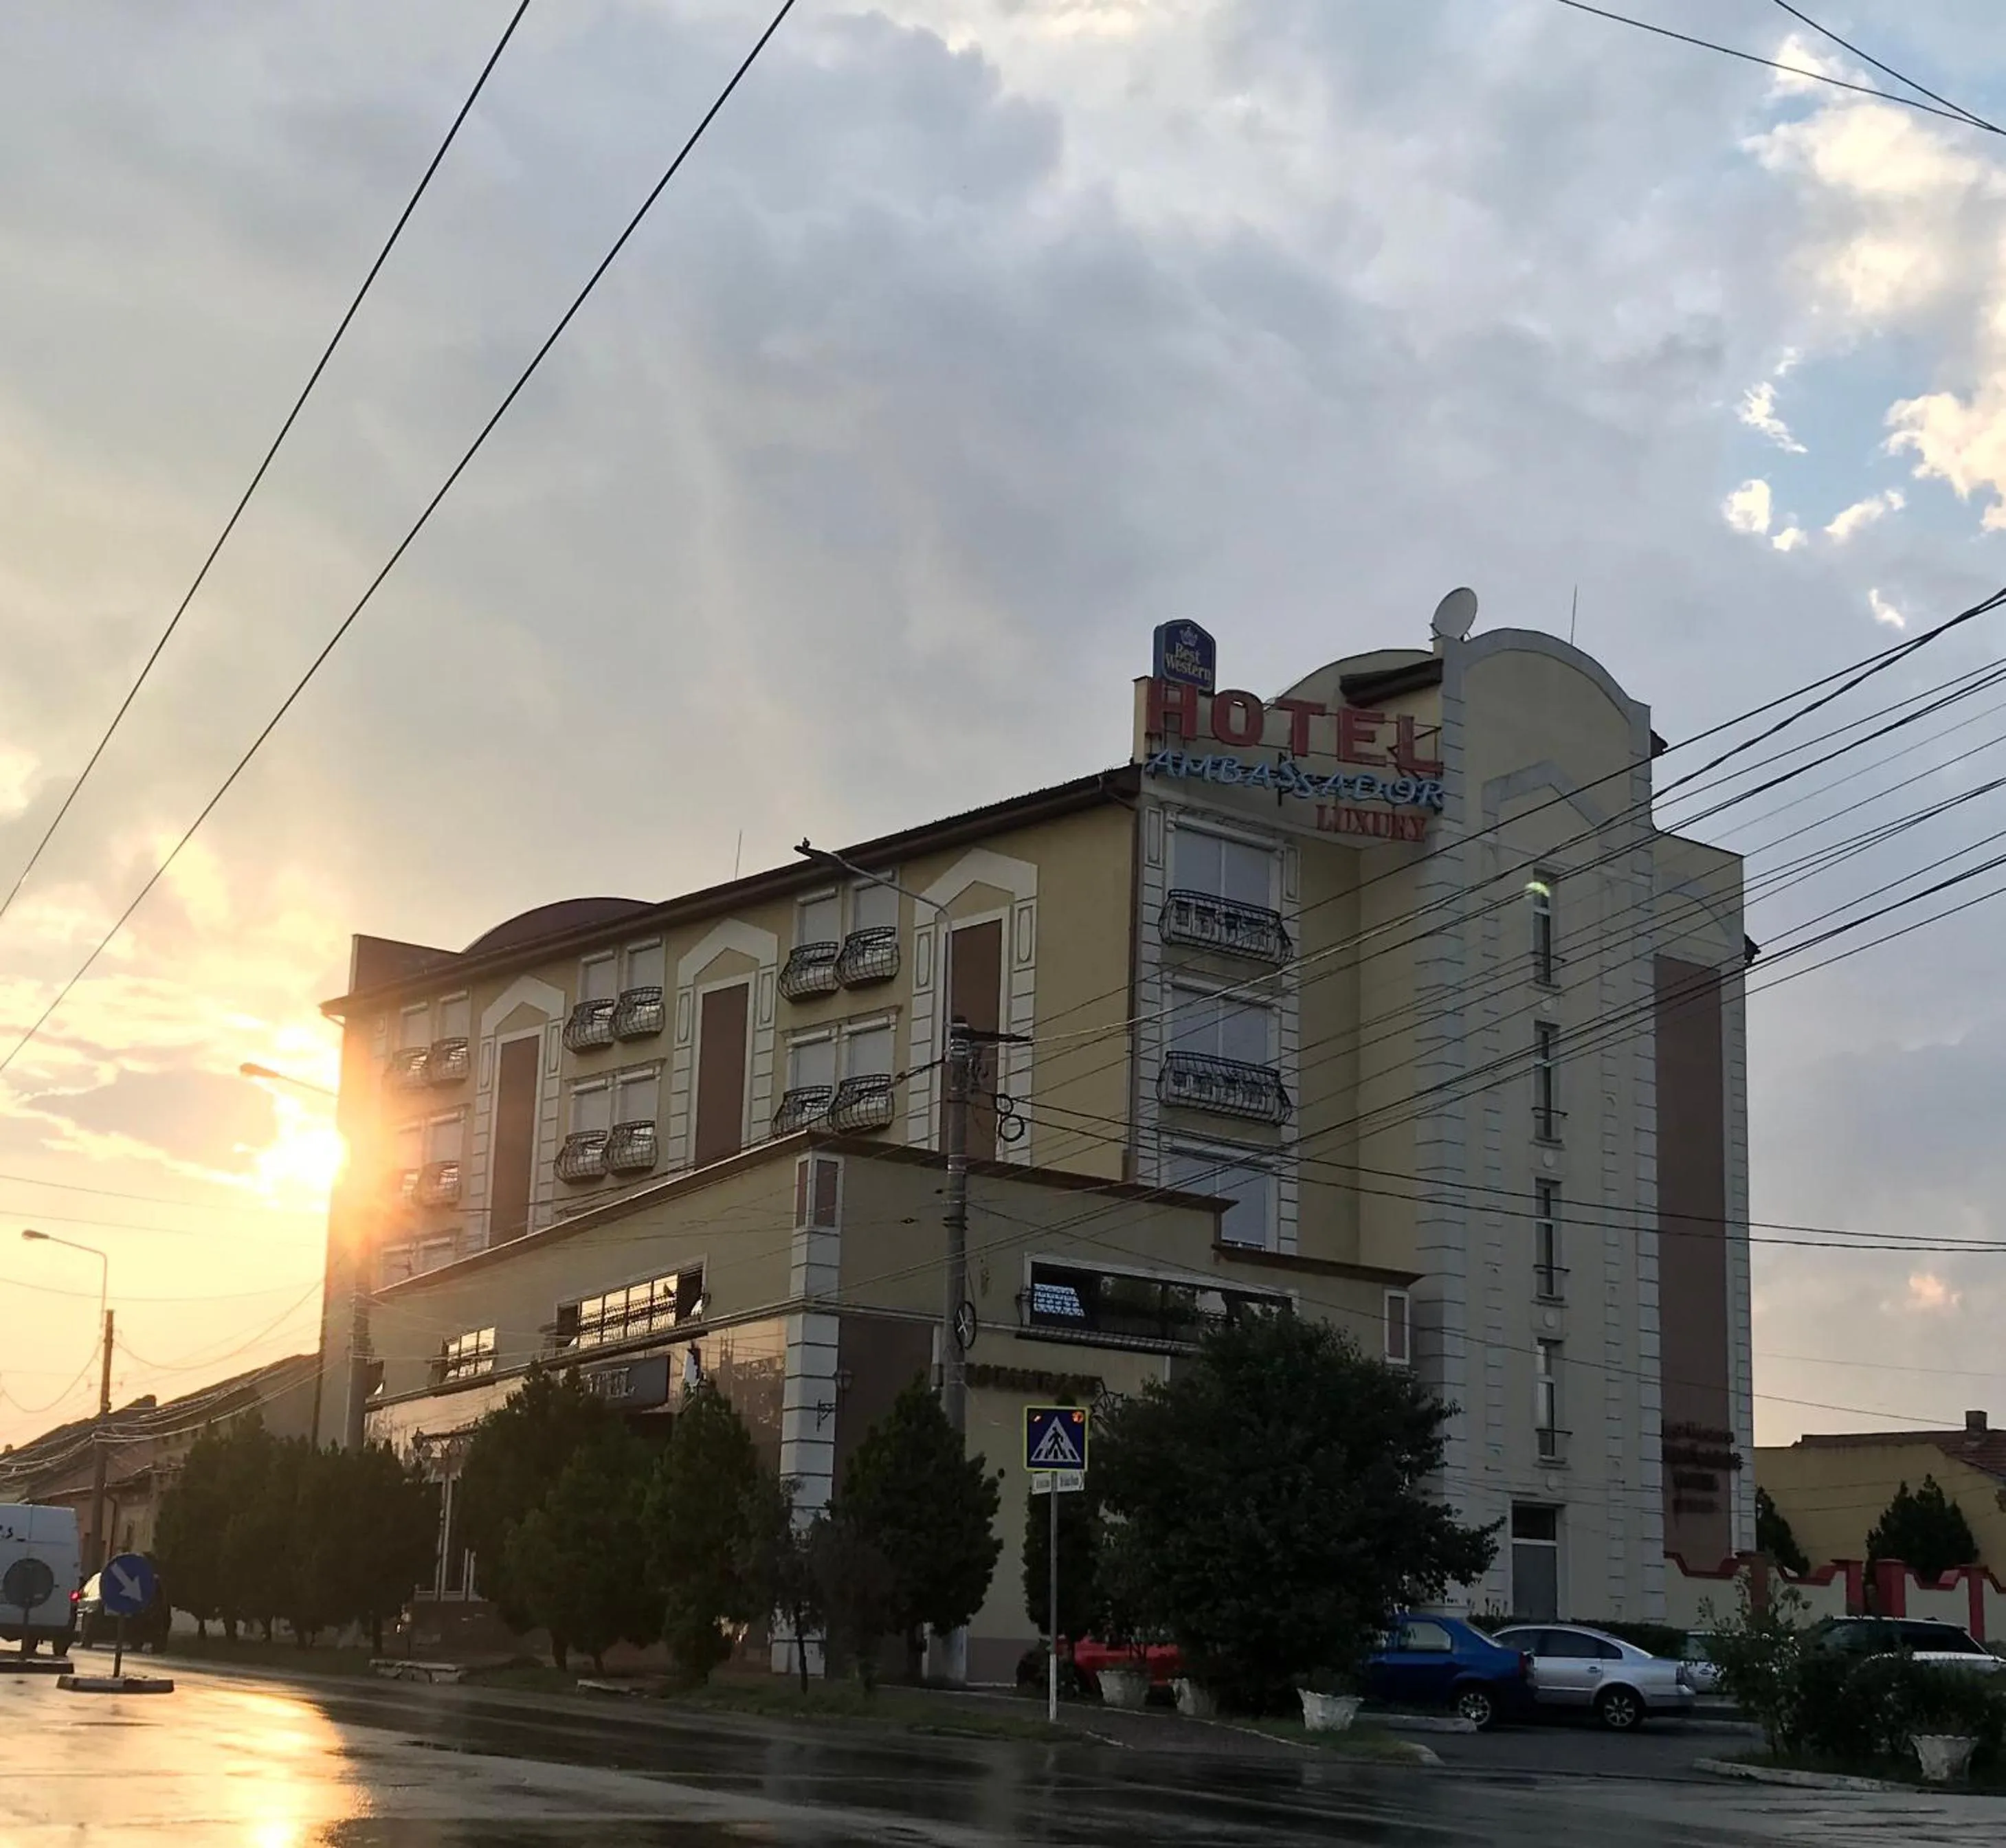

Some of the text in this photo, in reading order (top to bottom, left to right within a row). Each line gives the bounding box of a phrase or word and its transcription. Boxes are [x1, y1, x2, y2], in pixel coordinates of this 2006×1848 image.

[1166, 652, 1212, 682] Western
[1176, 642, 1201, 665] Best
[1147, 678, 1443, 773] HOTEL
[1145, 748, 1442, 808] AMBASSADOR
[1315, 805, 1427, 842] LUXURY
